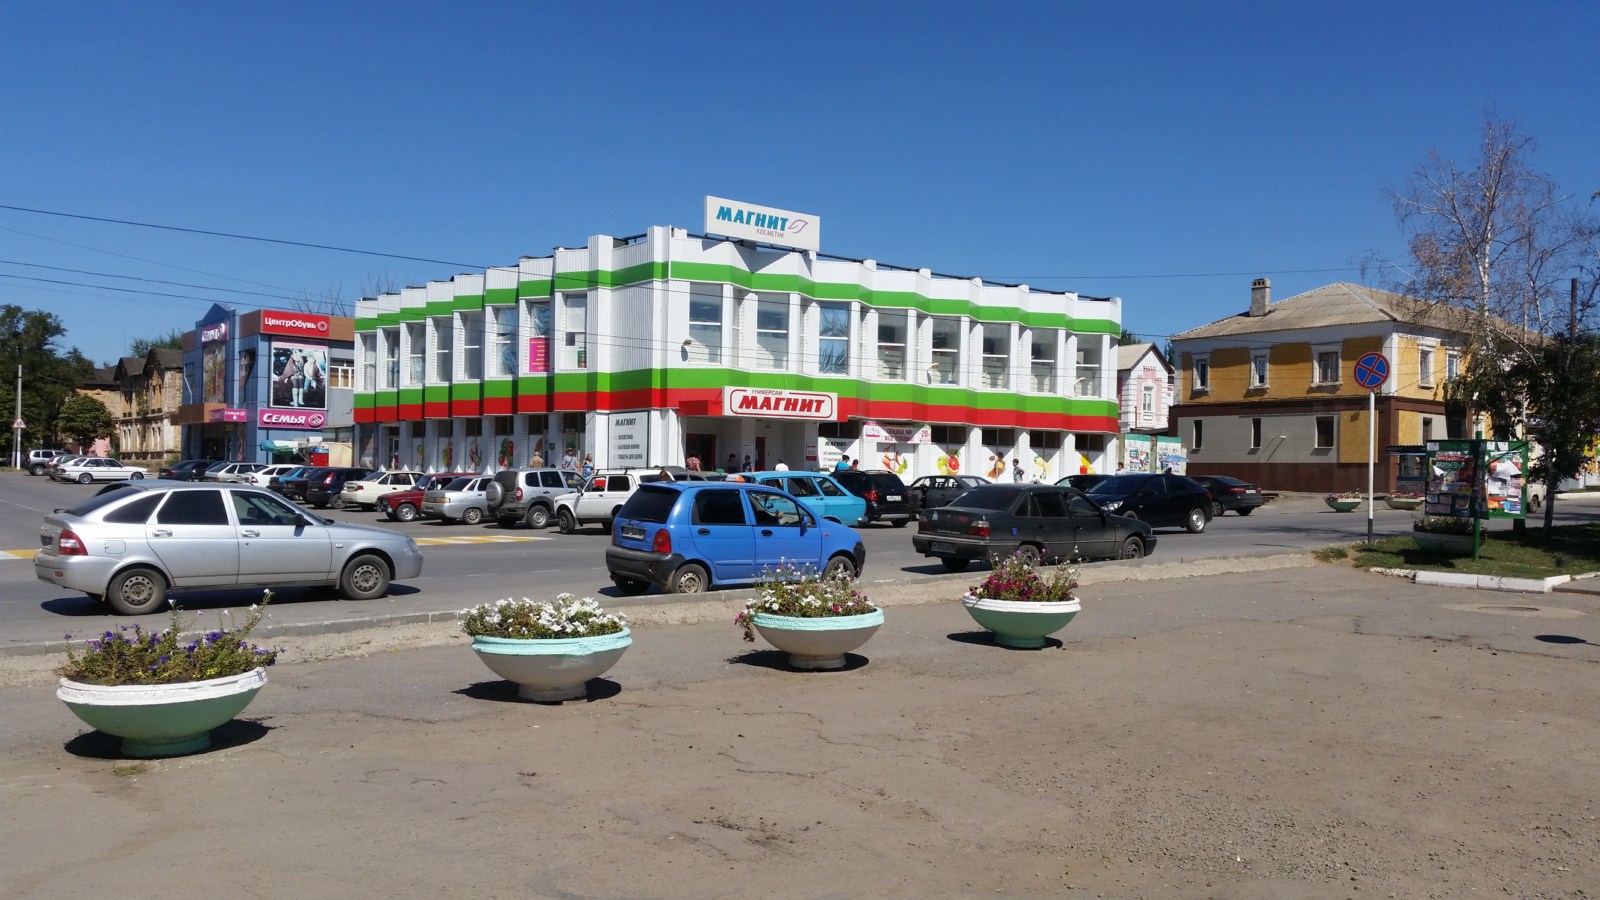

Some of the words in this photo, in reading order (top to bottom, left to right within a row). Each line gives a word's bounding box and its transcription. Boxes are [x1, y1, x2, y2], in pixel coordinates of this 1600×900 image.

[716, 205, 788, 231] МАГНИТ
[264, 317, 316, 329] ЦентрОбувь
[738, 395, 825, 413] МАГНИТ
[615, 418, 637, 427] МАГНИТ
